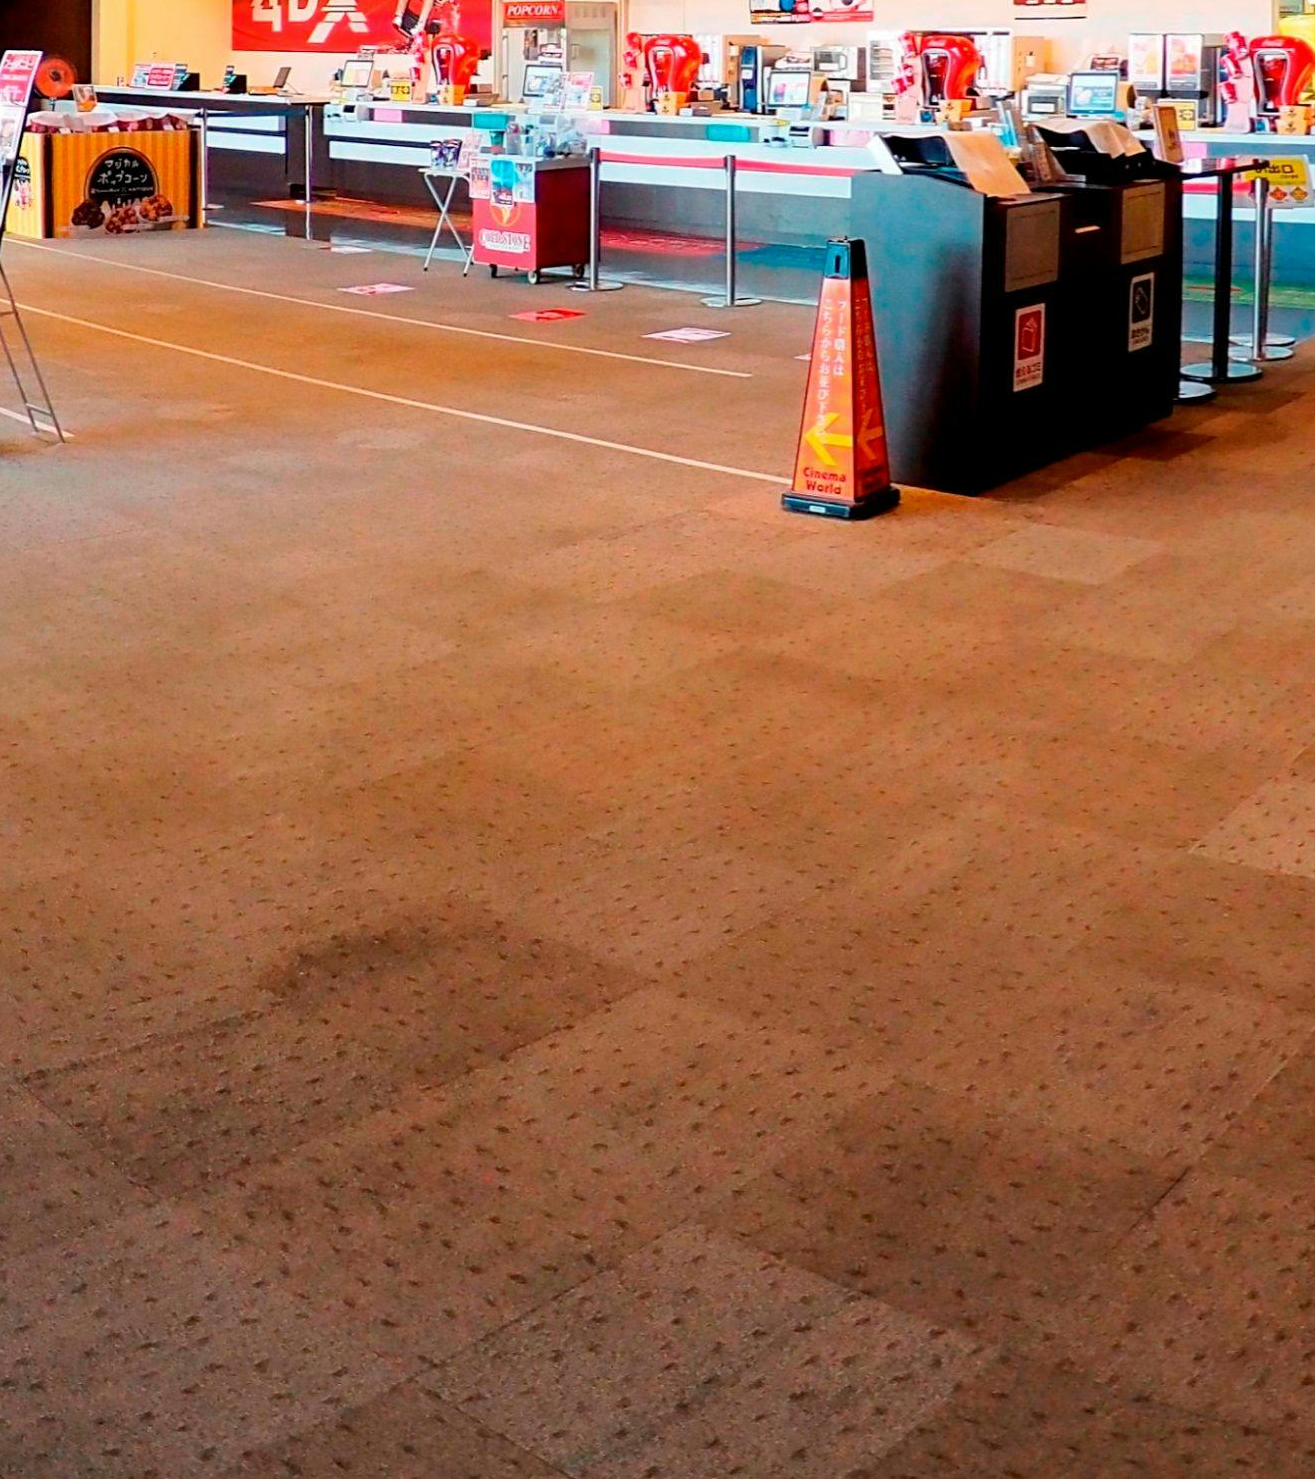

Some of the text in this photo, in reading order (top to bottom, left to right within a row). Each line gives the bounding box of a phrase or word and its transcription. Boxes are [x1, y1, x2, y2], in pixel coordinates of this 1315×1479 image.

[507, 4, 560, 17] POPCORN
[803, 466, 847, 483] Cinema
[806, 479, 842, 495] World
